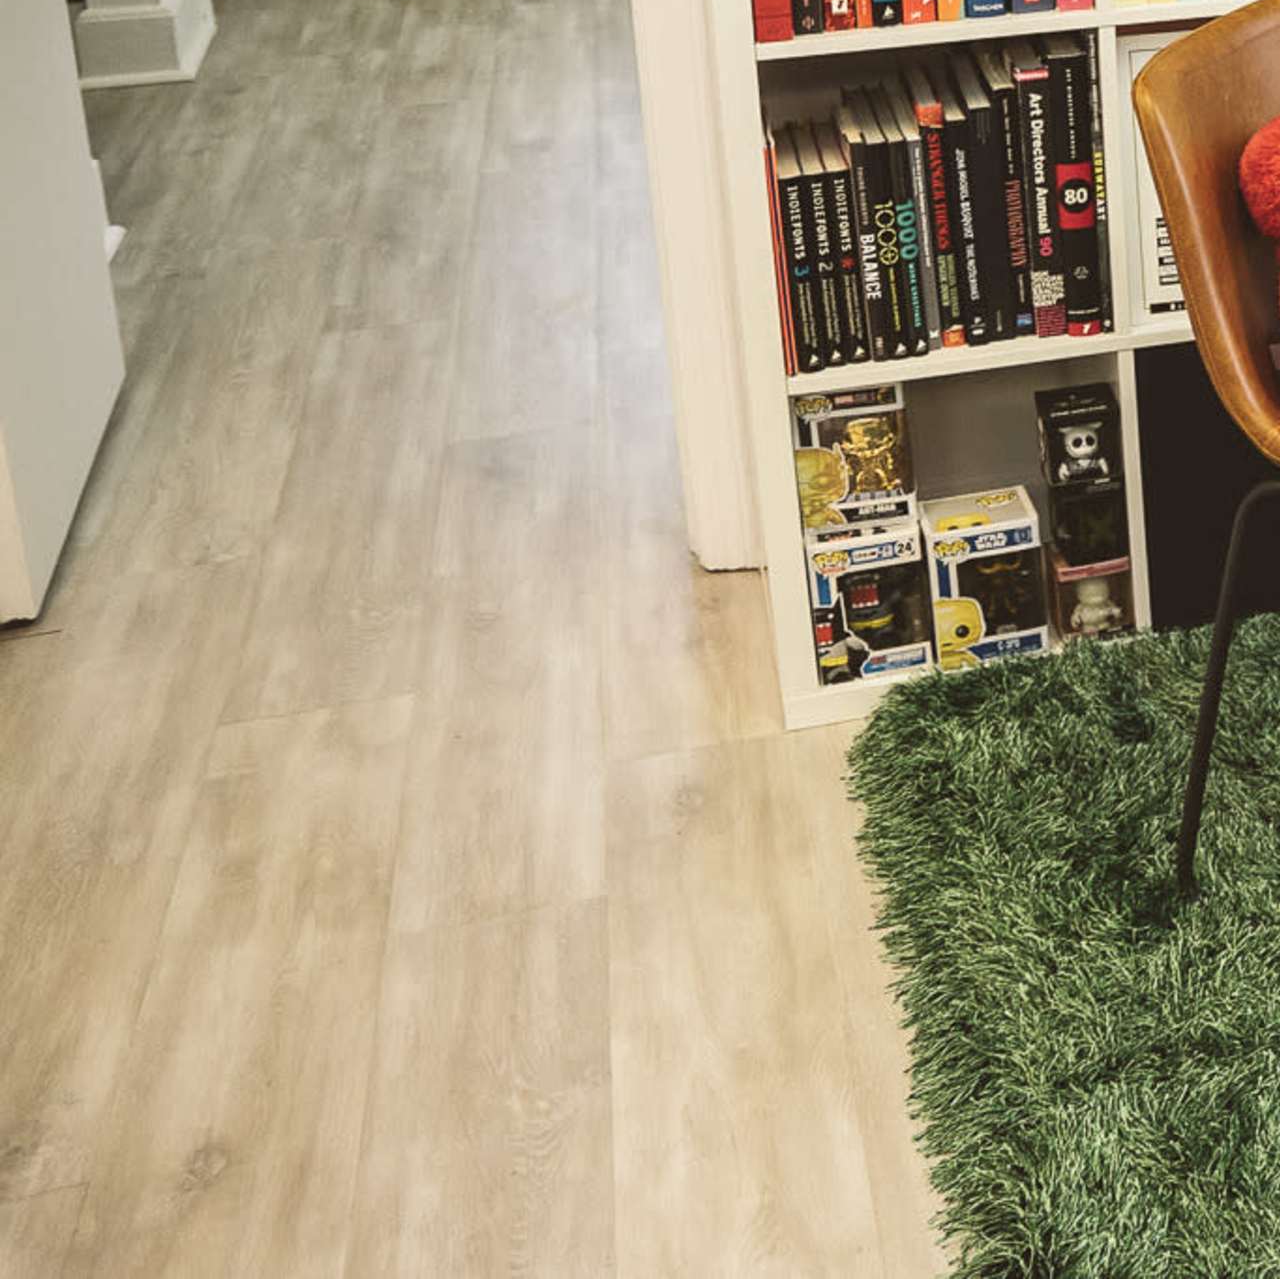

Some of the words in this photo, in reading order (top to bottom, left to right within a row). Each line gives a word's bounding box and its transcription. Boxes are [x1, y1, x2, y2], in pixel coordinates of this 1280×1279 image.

[1028, 92, 1043, 117] Art
[927, 131, 947, 201] STRANGER
[1030, 120, 1049, 184] Directors
[1035, 186, 1052, 235] Annual
[1064, 187, 1088, 205] 80
[895, 198, 919, 260] 1000
[932, 203, 950, 251] THINGS
[960, 201, 974, 240] BASQUIAT
[1004, 179, 1028, 267] PHOTOGRAPHY
[818, 261, 833, 273] 2
[860, 233, 882, 300] BALANCE
[965, 243, 975, 258] THE
[1039, 236, 1053, 257] 90
[794, 264, 810, 277] 3
[966, 258, 980, 301] NOTEBOOKS
[896, 541, 913, 555] 24
